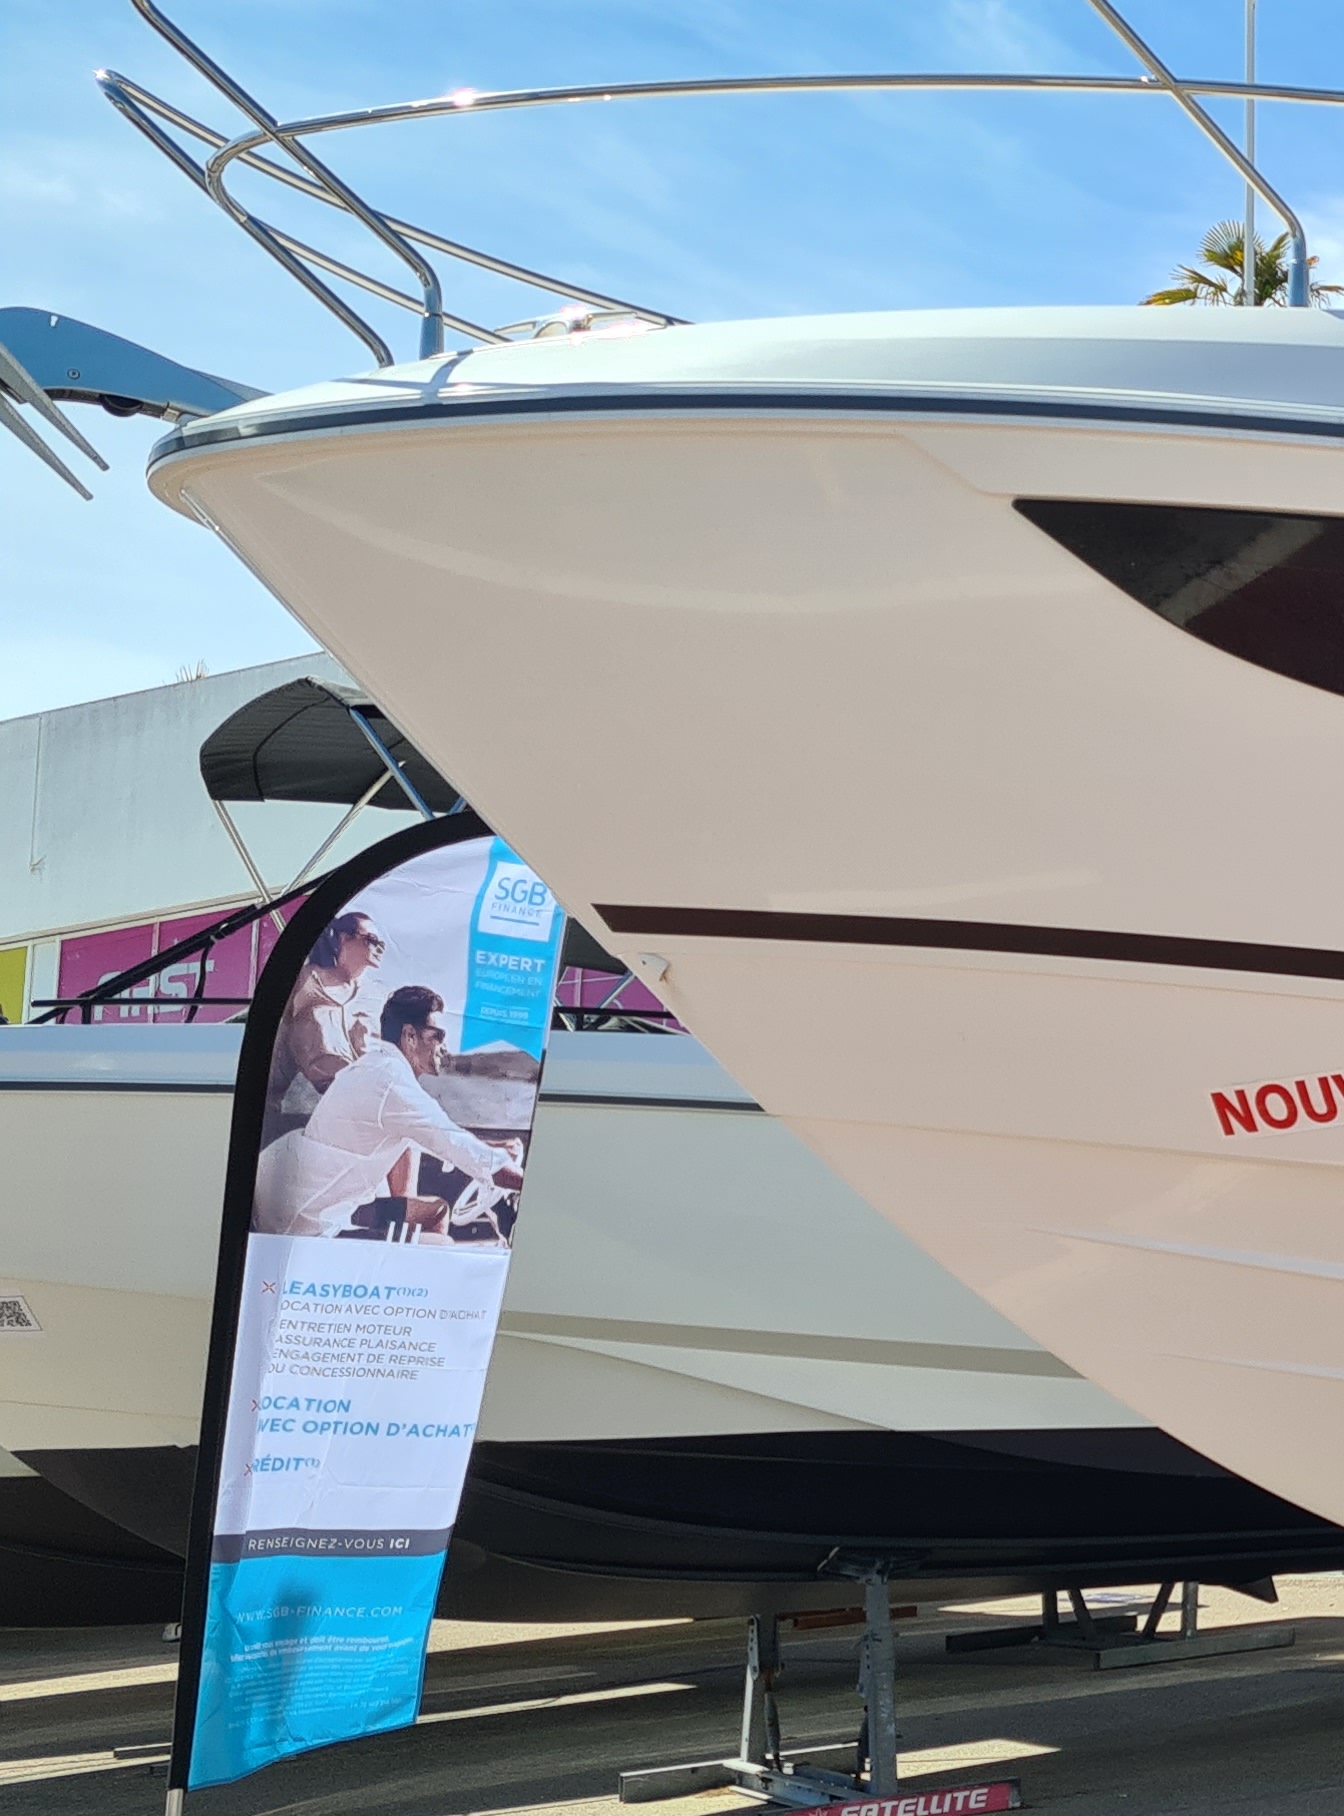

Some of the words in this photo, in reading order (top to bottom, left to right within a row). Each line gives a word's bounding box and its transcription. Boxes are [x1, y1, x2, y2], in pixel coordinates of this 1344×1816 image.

[494, 877, 548, 906] SGB
[491, 902, 542, 918] FINANCE
[475, 950, 546, 973] EXPERT
[280, 1300, 343, 1315] OCATION
[344, 1304, 381, 1316] AVEC
[383, 1306, 437, 1320] OPTION
[279, 1319, 352, 1335] ENTRETIEN
[355, 1324, 413, 1337] MOTEUR
[275, 1335, 357, 1348] ASSURANCE
[359, 1339, 438, 1353] PLAISANCE
[366, 1353, 386, 1365] DE
[388, 1355, 446, 1367] REPRISE
[289, 1364, 420, 1381] CONCESSIONNAIRE
[260, 1396, 351, 1413] OCATION
[258, 1418, 296, 1434] VEC
[302, 1419, 381, 1436] OPTION
[248, 1537, 384, 1550] RENSEIGNEZ-VOUS
[389, 1538, 411, 1549] ICI
[841, 1788, 989, 1816] SATELLITE
